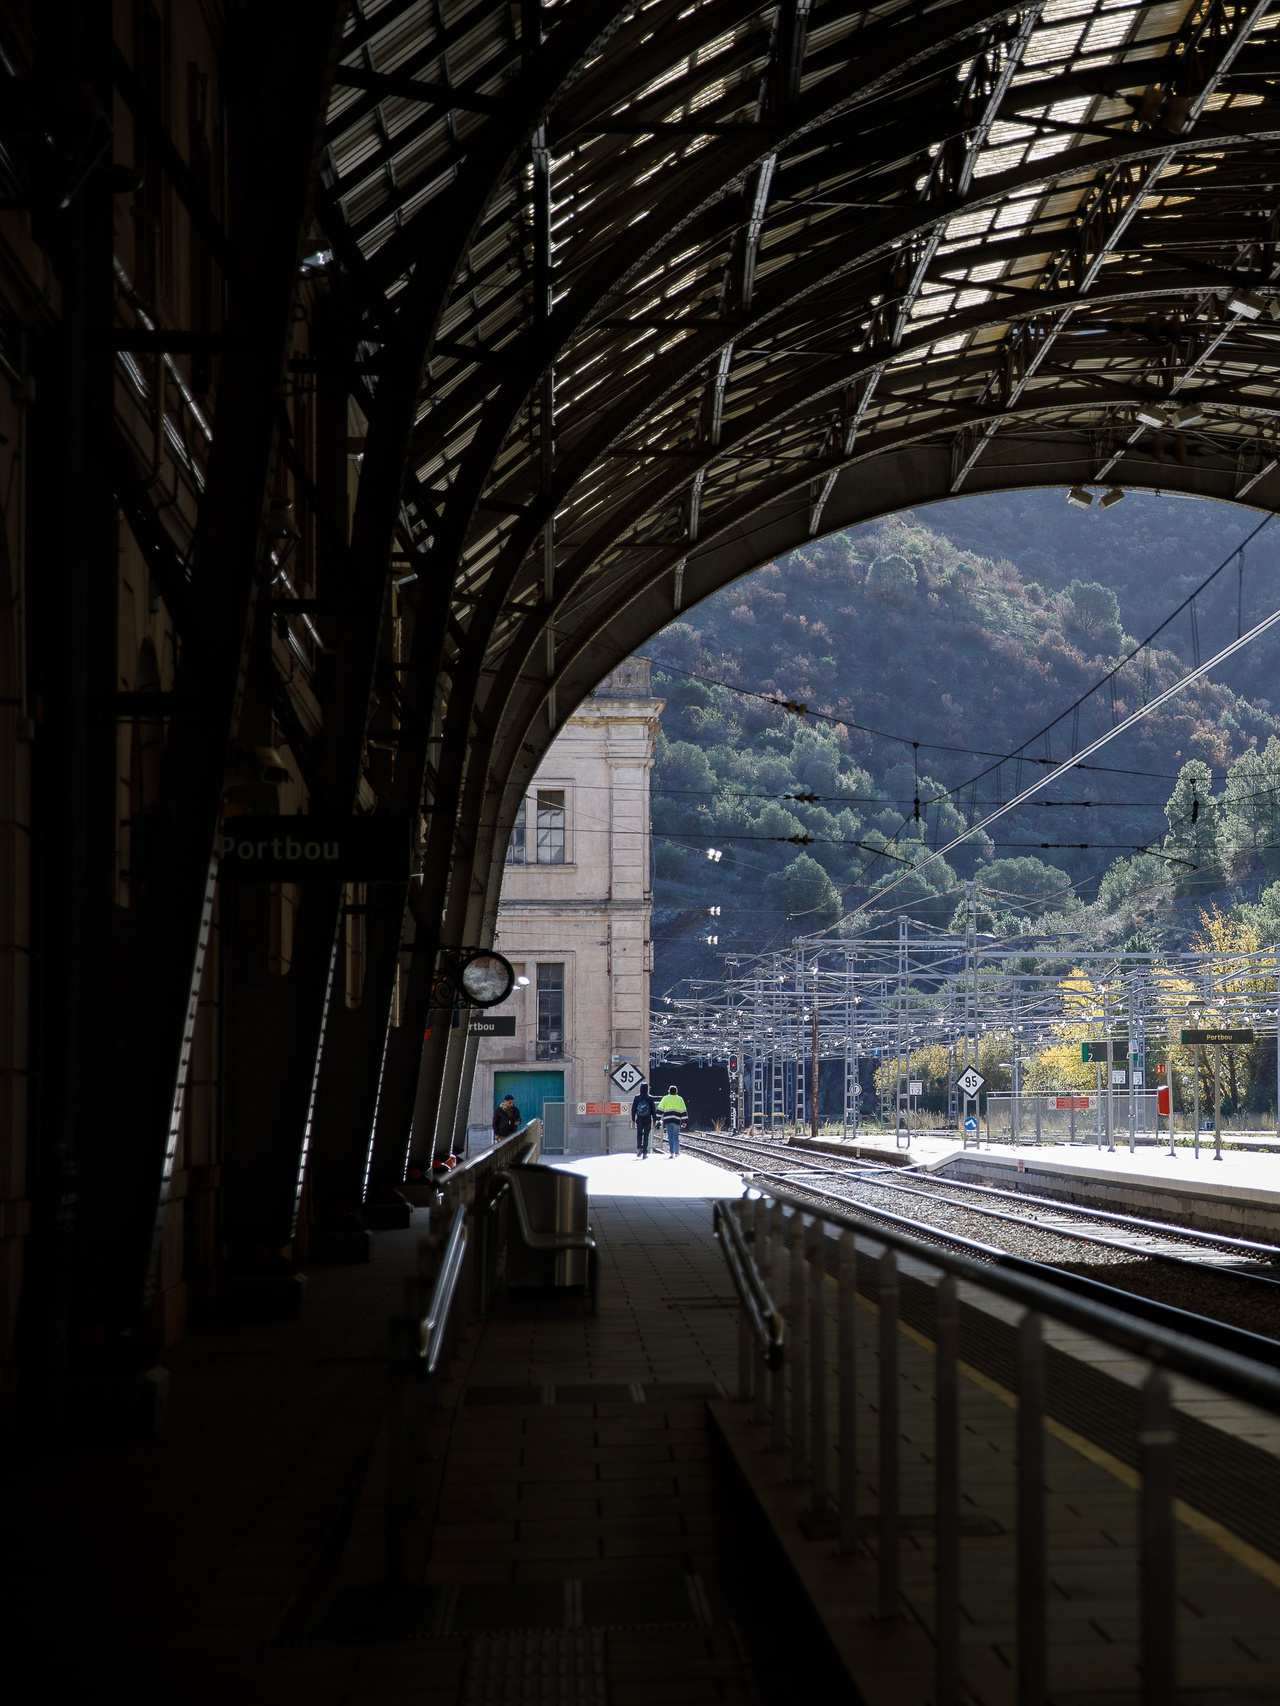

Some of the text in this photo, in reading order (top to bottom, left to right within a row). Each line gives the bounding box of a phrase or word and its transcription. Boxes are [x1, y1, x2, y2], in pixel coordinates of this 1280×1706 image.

[220, 835, 340, 860] Portbou
[1087, 1053, 1093, 1062] 2
[620, 1071, 634, 1083] 95
[965, 1075, 978, 1088] 95
